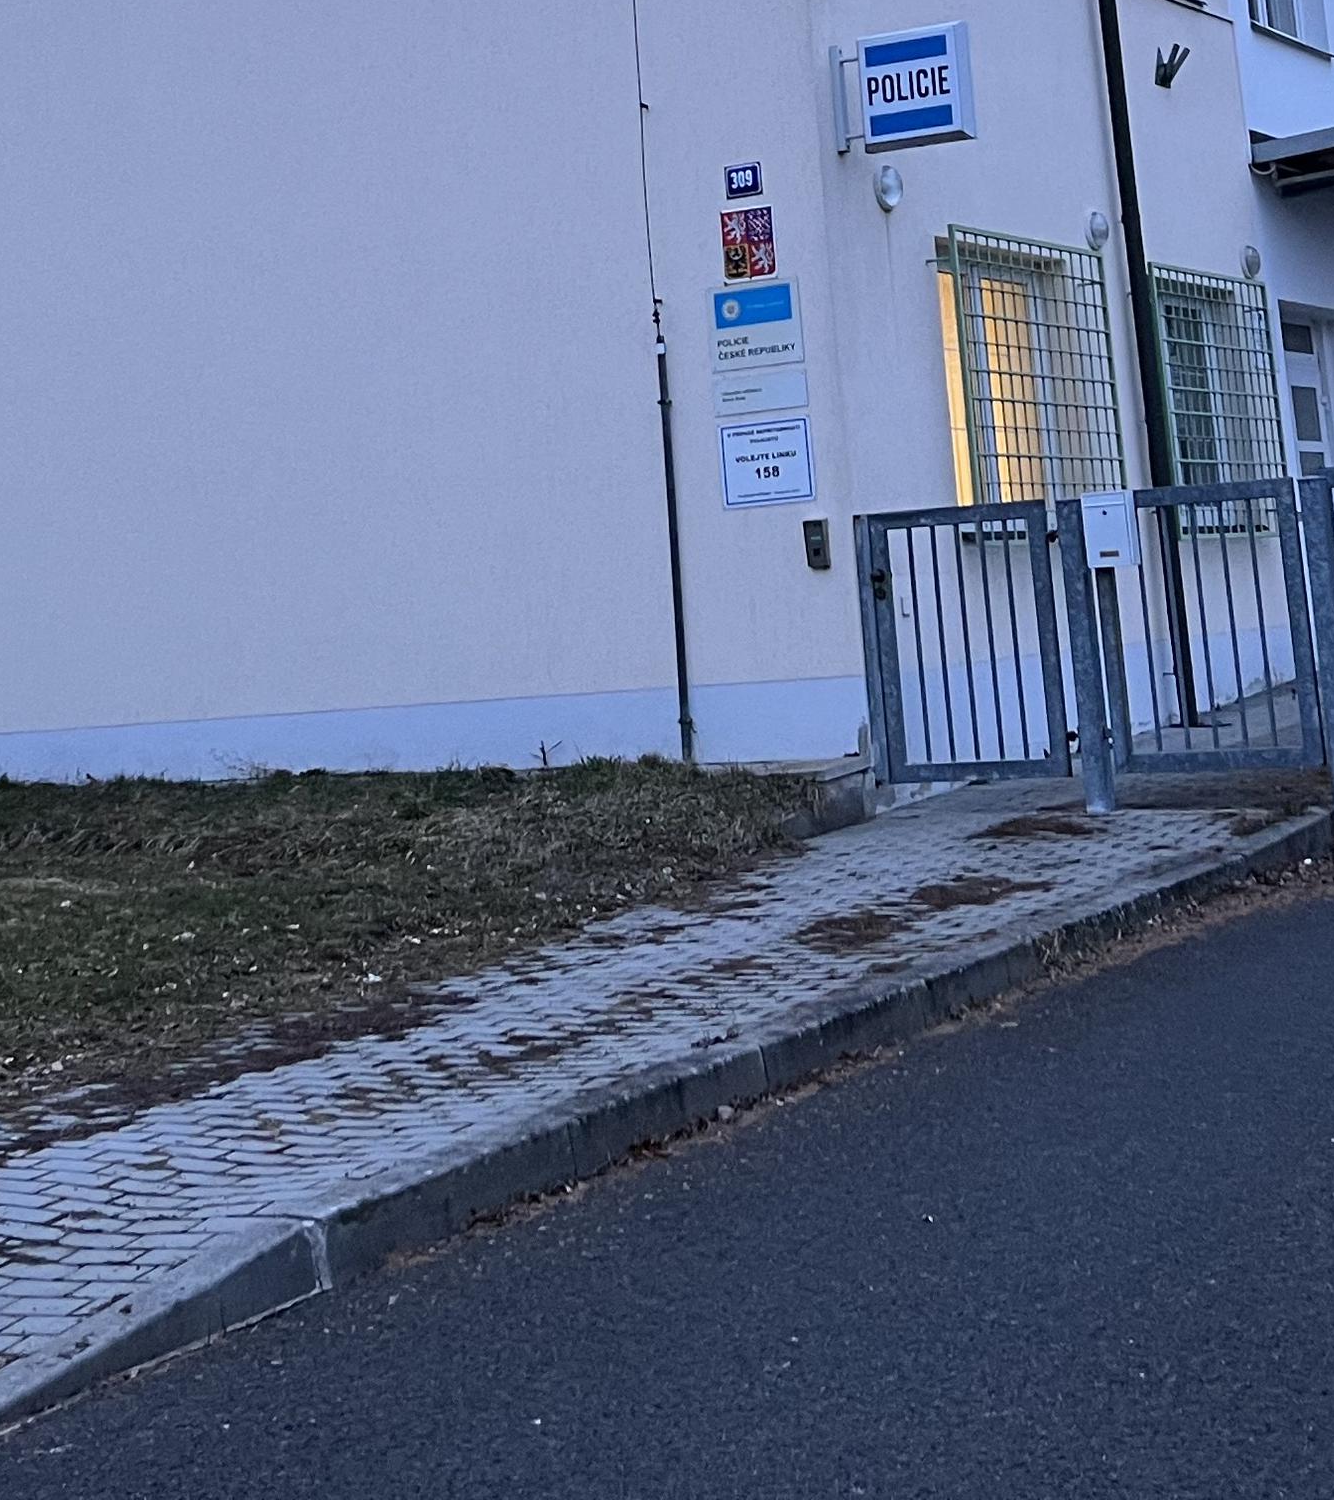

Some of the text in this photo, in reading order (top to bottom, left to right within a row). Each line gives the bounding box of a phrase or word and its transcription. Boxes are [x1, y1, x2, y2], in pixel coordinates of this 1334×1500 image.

[867, 65, 950, 106] POLICIE
[730, 169, 753, 189] 309
[717, 336, 749, 348] POLICIE
[718, 348, 746, 361] ČESKÉ
[735, 453, 769, 463] VOLEJTE
[755, 465, 780, 479] 158
